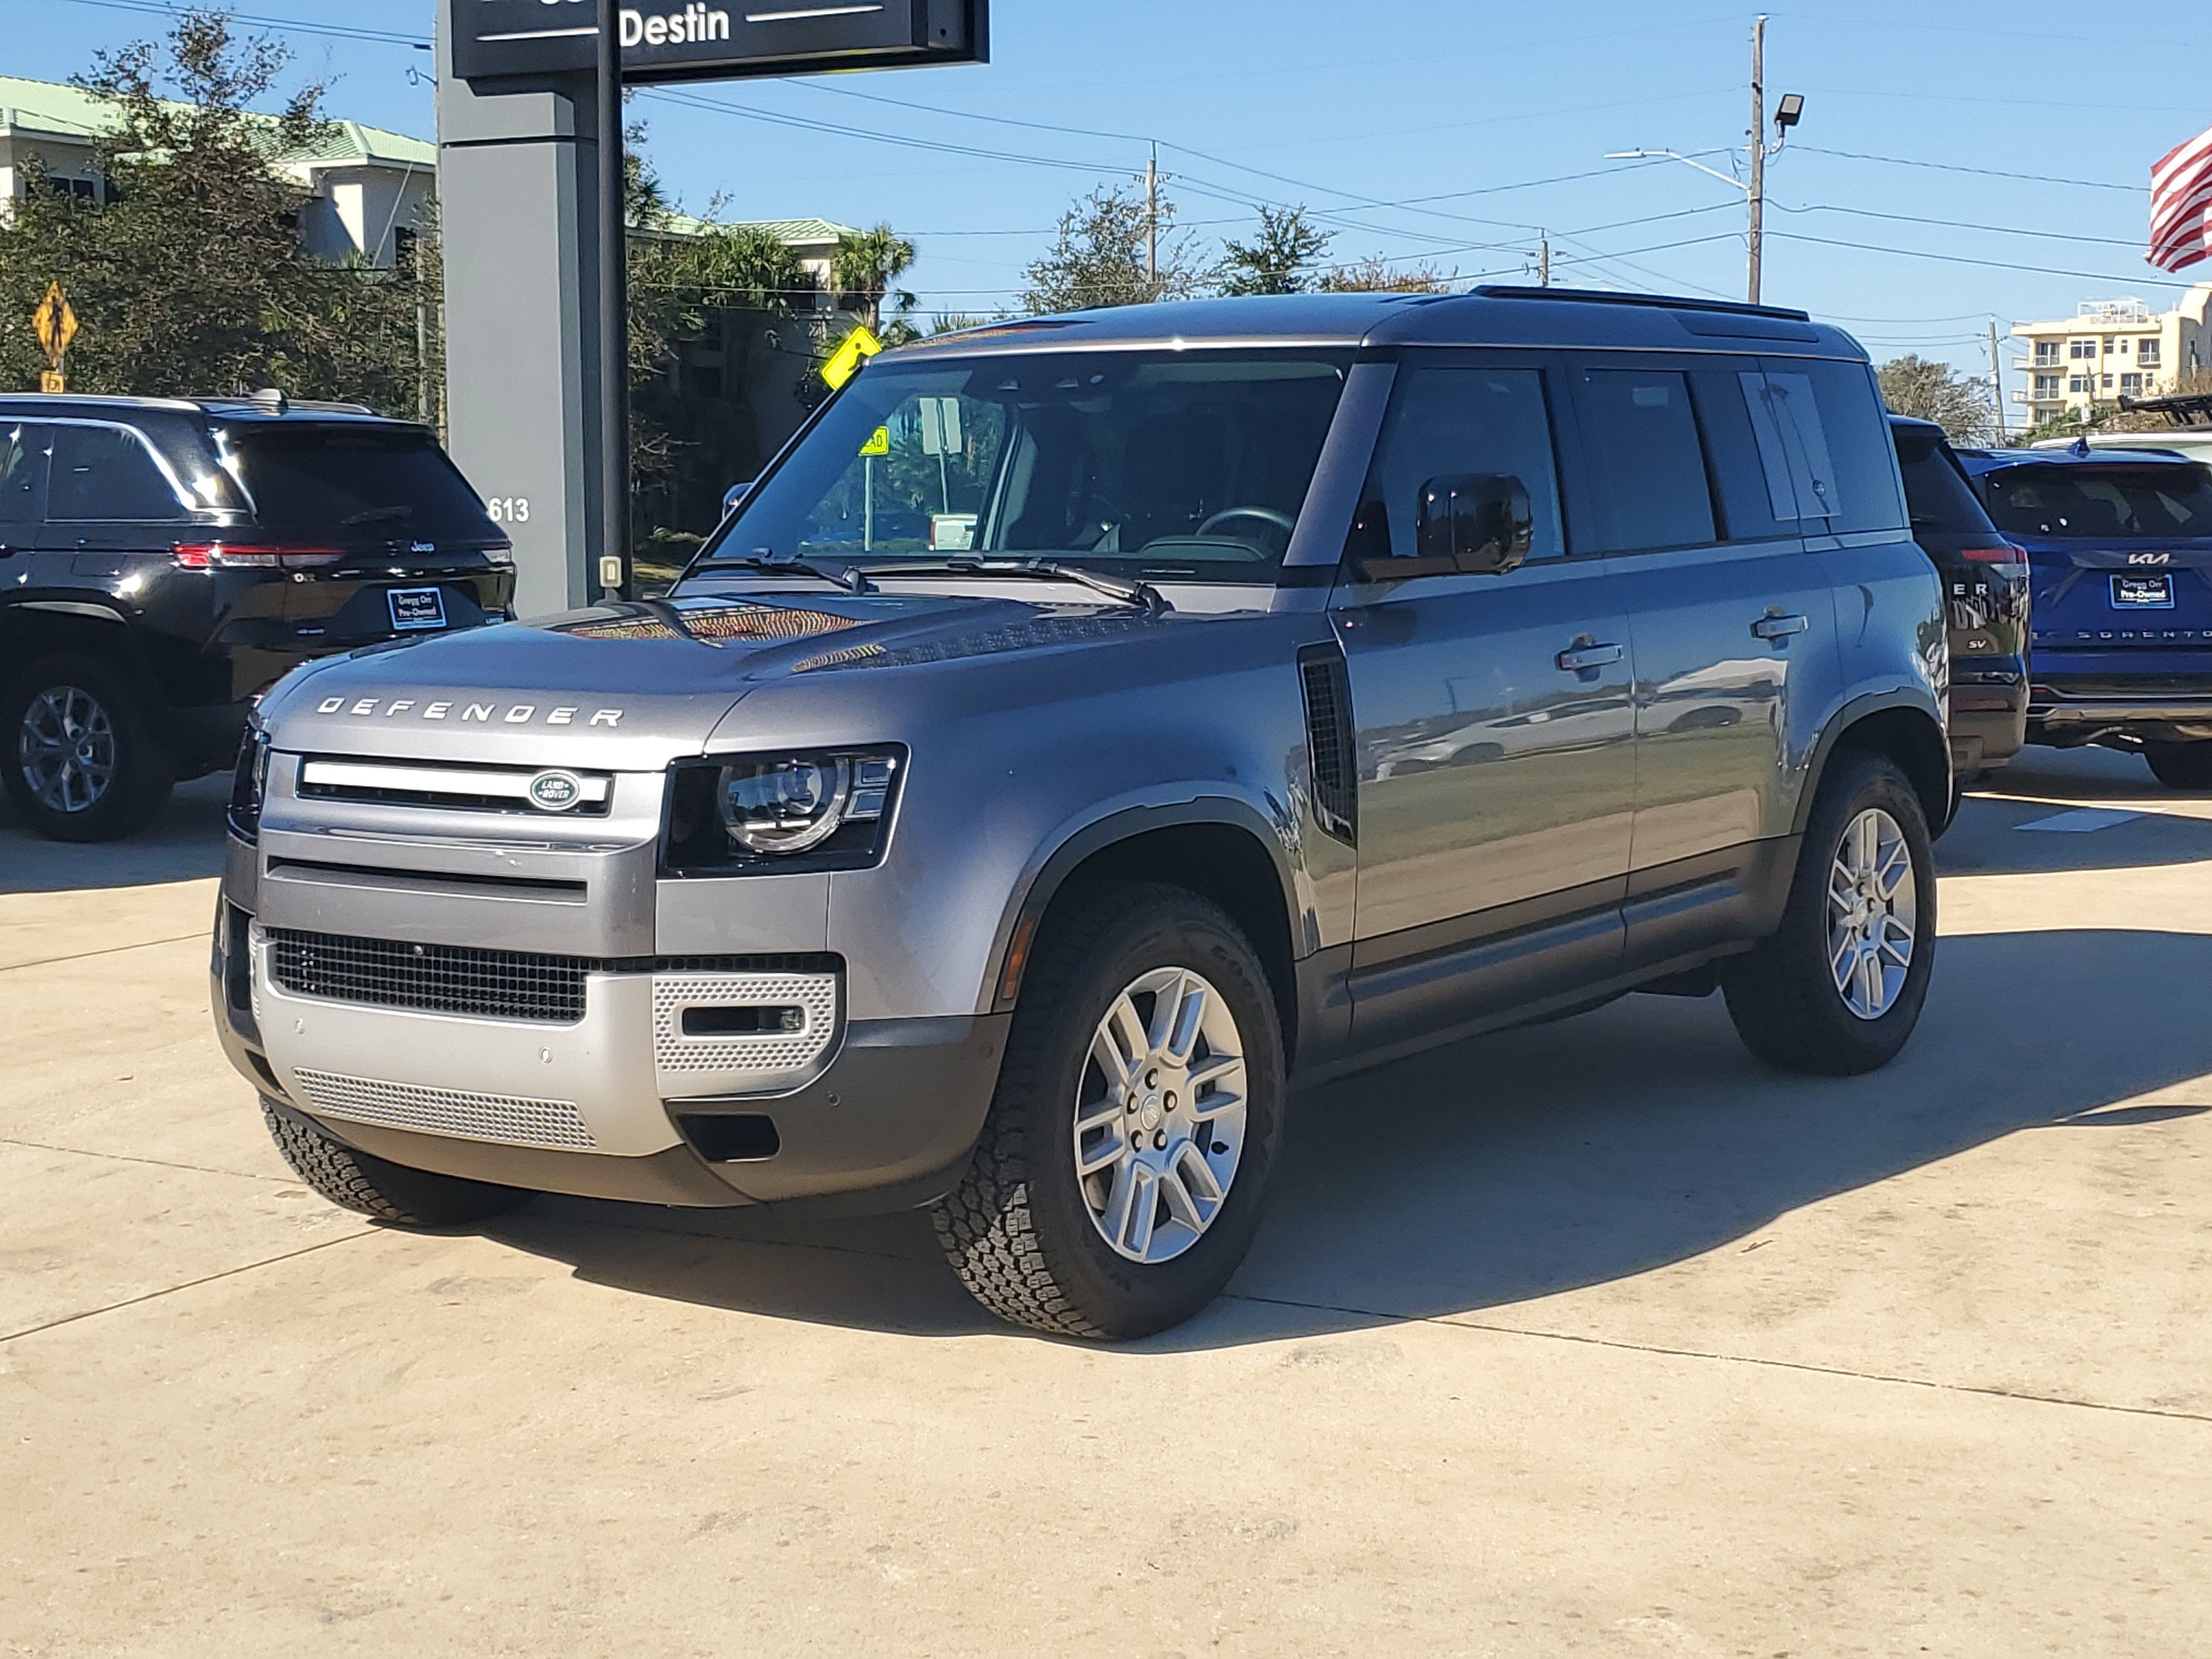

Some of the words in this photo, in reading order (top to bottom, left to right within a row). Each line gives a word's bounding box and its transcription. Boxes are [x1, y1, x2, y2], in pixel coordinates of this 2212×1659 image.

[619, 2, 730, 47] Destin
[489, 497, 529, 522] 613
[2128, 553, 2170, 565] KIA
[2120, 590, 2166, 599] Pre-Owned
[1968, 640, 1987, 648] SV
[317, 696, 624, 727] DEFENDER
[541, 780, 565, 790] LAND
[542, 789, 570, 799] ROVER
